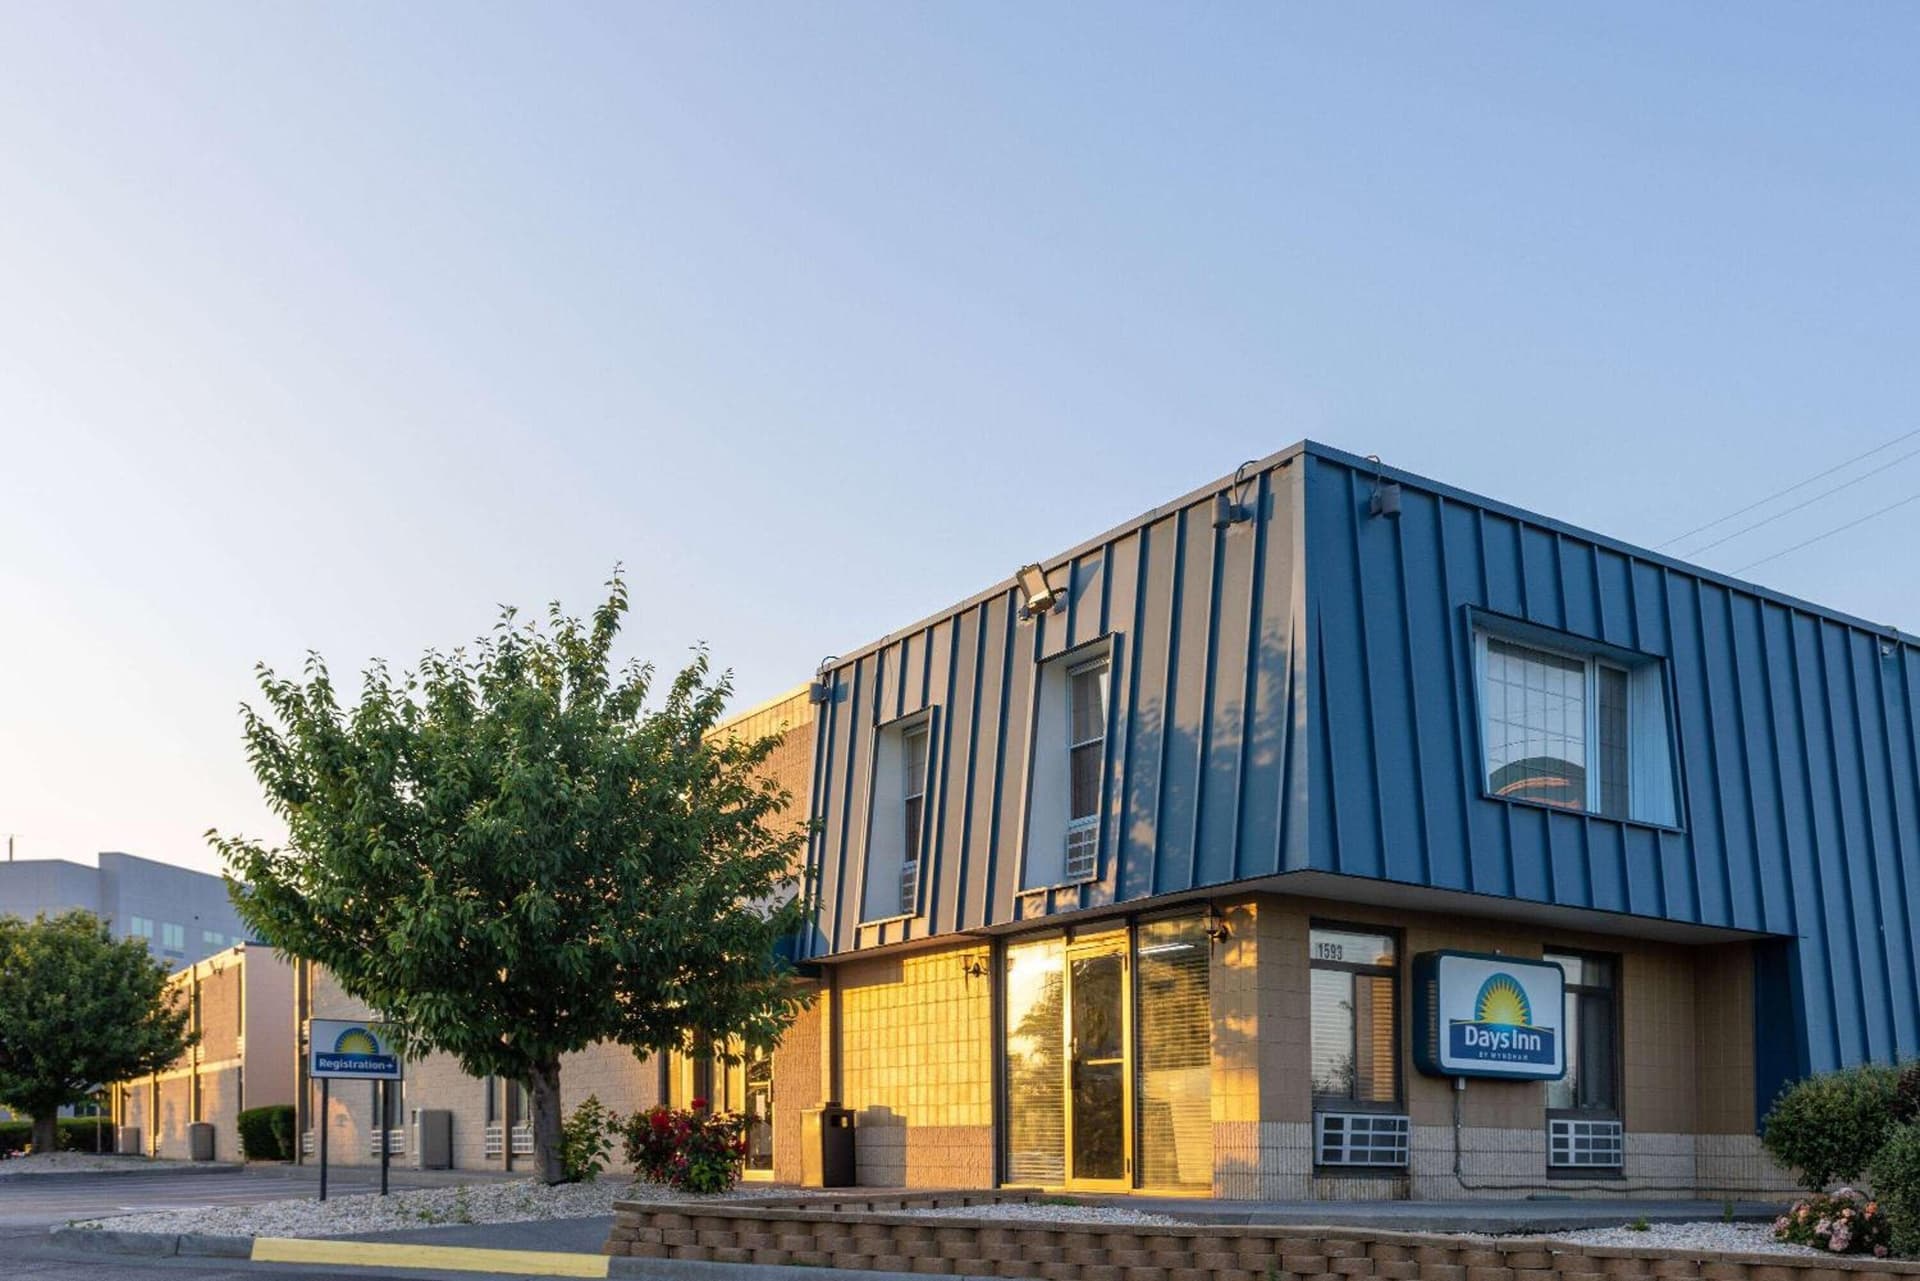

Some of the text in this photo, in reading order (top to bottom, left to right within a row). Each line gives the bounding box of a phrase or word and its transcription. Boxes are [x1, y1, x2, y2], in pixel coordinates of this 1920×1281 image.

[1318, 943, 1343, 960] 1593
[1464, 1025, 1541, 1051] Days Inn
[1490, 1051, 1529, 1061] WYNDHAM
[319, 1058, 385, 1070] Registration
